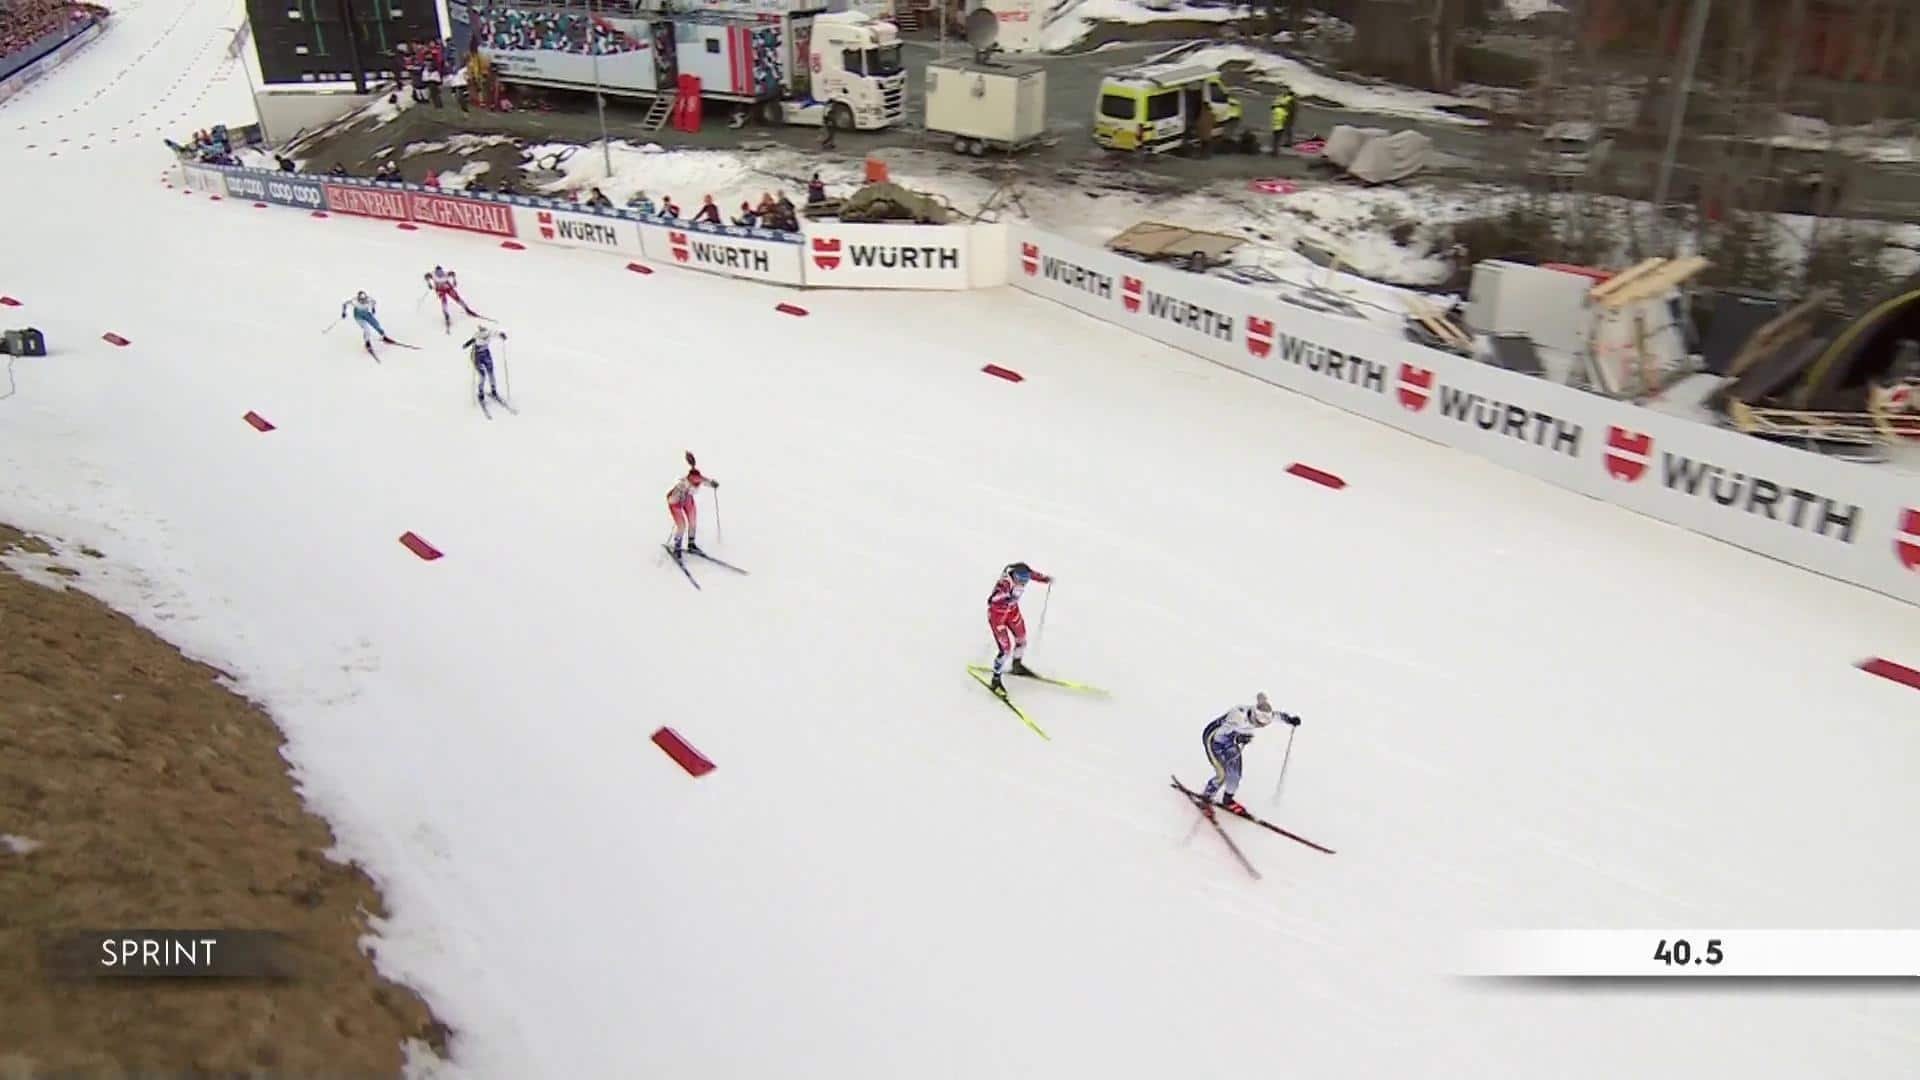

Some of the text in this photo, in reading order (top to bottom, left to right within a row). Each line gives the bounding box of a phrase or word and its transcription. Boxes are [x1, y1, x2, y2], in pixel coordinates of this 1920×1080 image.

[344, 188, 405, 218] GENERALI
[432, 199, 510, 233] GENERALI
[556, 219, 618, 246] WÜRTH
[692, 242, 770, 272] WÜRTH
[850, 244, 959, 269] WÜRTH
[1042, 255, 1113, 300] WÜRTH
[1147, 290, 1235, 342] WÜRTH
[1279, 332, 1388, 394] WÜRTH
[1440, 384, 1583, 458] WÜRTH
[1663, 451, 1863, 544] WÜRTH
